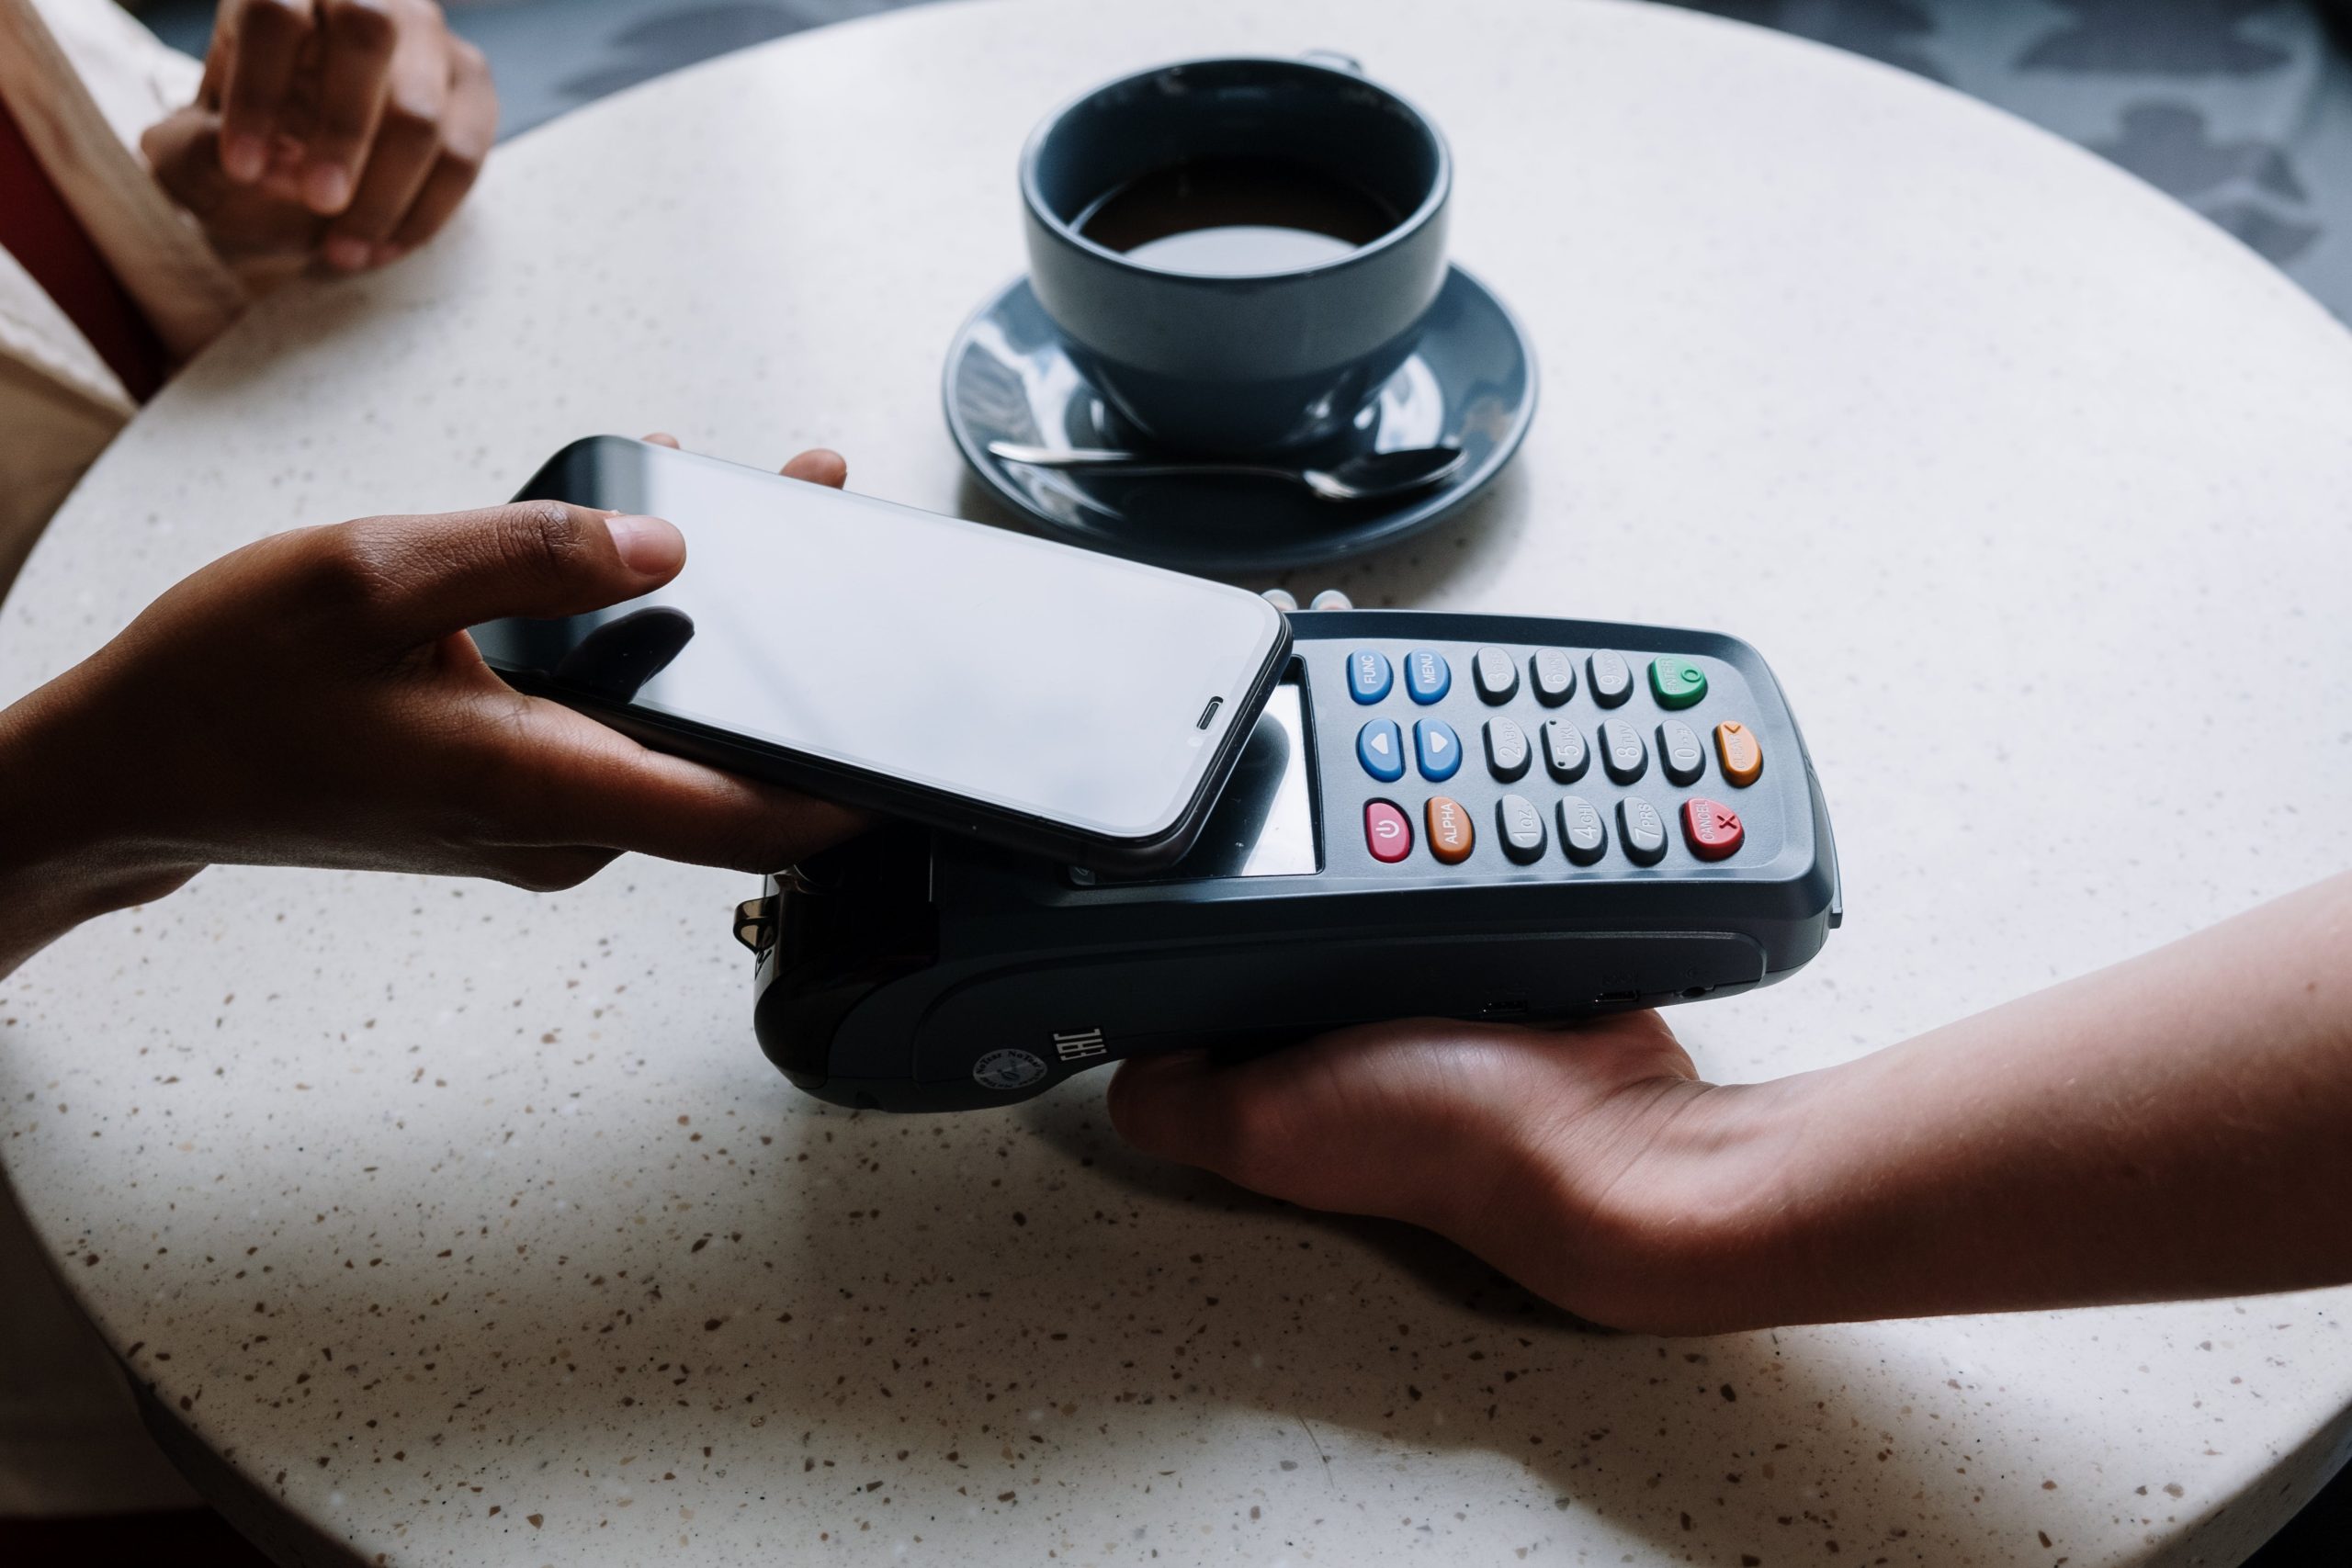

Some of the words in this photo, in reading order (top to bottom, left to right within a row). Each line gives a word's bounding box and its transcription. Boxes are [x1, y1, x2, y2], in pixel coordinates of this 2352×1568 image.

[1361, 655, 1376, 683] FUNC
[1422, 653, 1436, 683] MENU
[1661, 658, 1678, 692] ENTER
[1442, 803, 1459, 844] ALPHA
[1698, 800, 1715, 841] CANCEL
